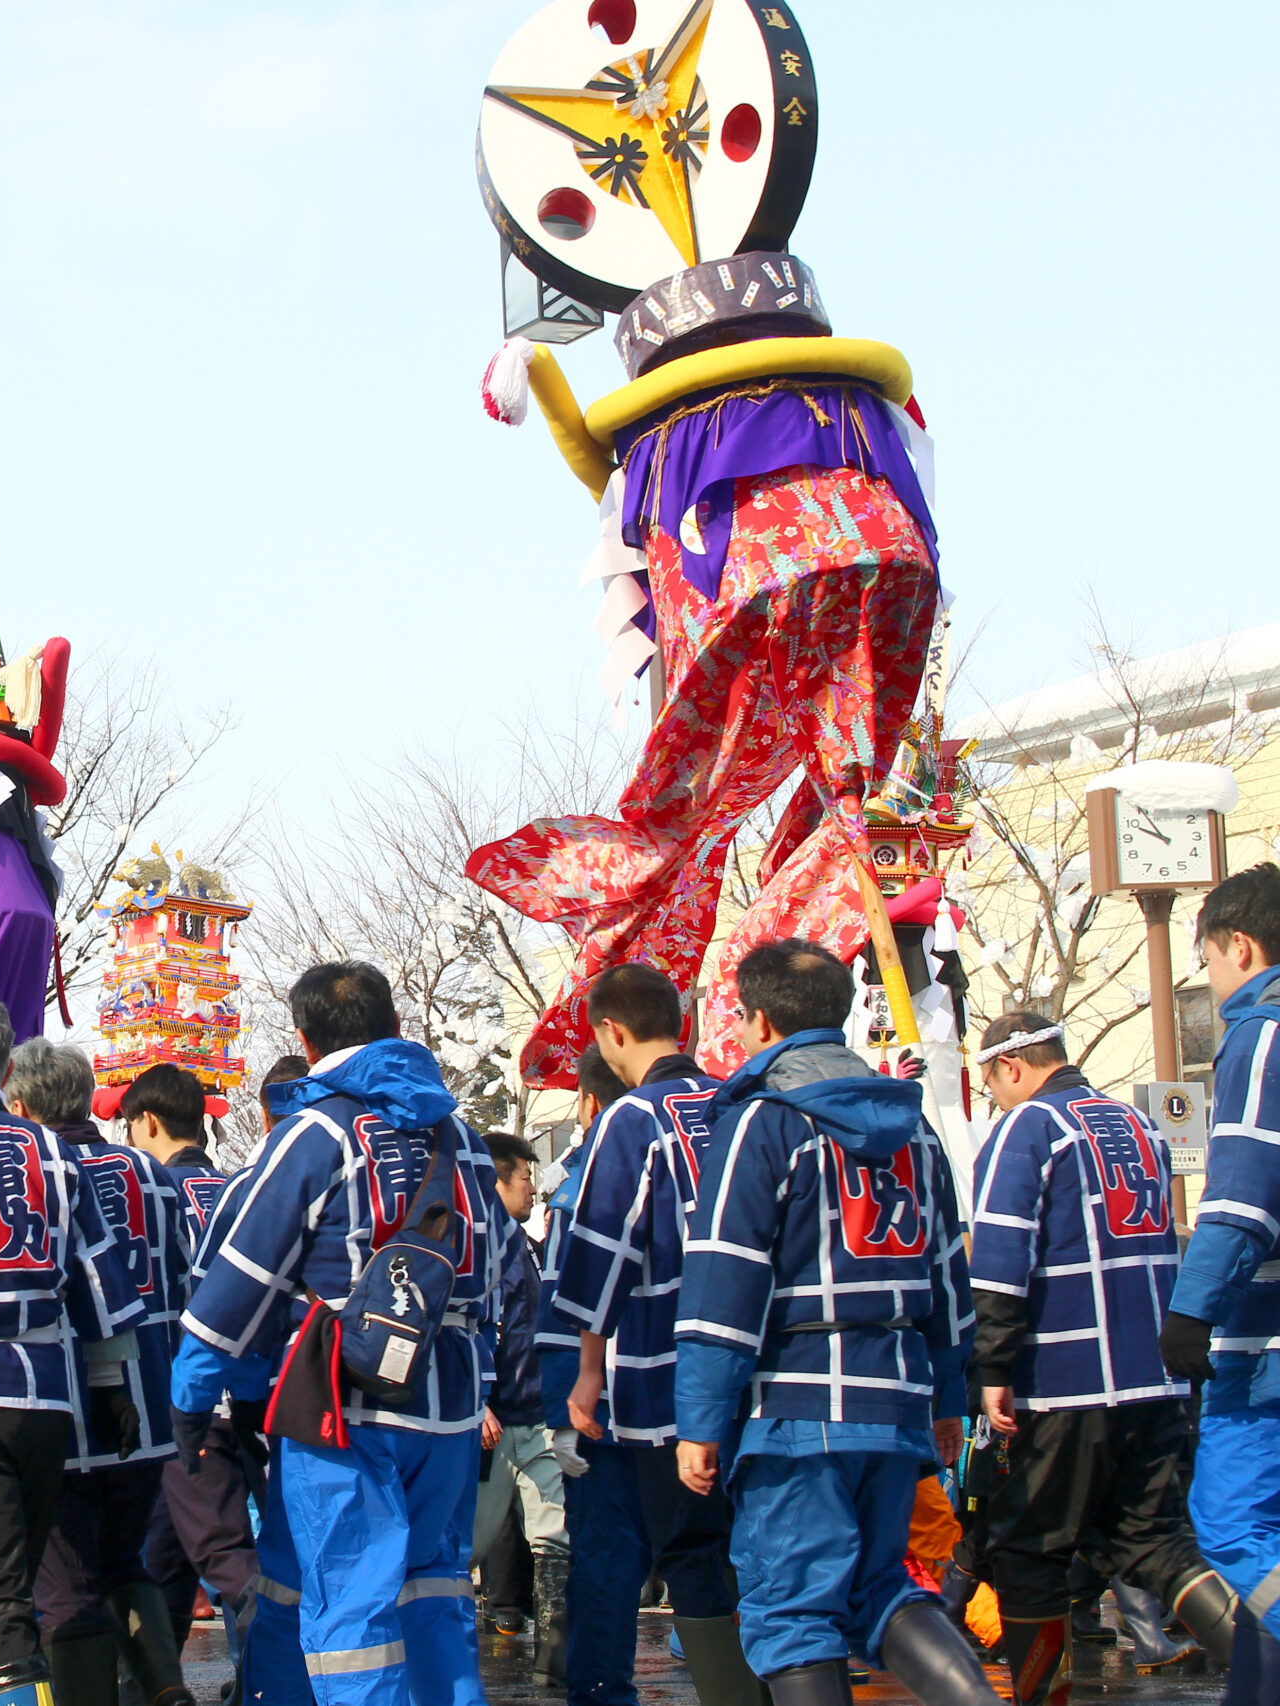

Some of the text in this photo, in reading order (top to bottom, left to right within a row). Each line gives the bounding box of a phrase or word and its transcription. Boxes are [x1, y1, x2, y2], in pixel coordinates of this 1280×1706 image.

[760, 8, 807, 126] 通安全
[1126, 819, 1140, 829] 10
[1186, 814, 1196, 824] 2
[1122, 834, 1133, 843] 9
[1191, 832, 1202, 841] 3
[1128, 850, 1138, 859] 8
[1189, 847, 1198, 858] 4
[1142, 863, 1153, 873] 7
[1177, 861, 1187, 870] 5
[1160, 867, 1170, 877] 6
[875, 990, 889, 1028] 友和会
[1172, 1098, 1182, 1114] L
[1074, 1103, 1163, 1229] 電力
